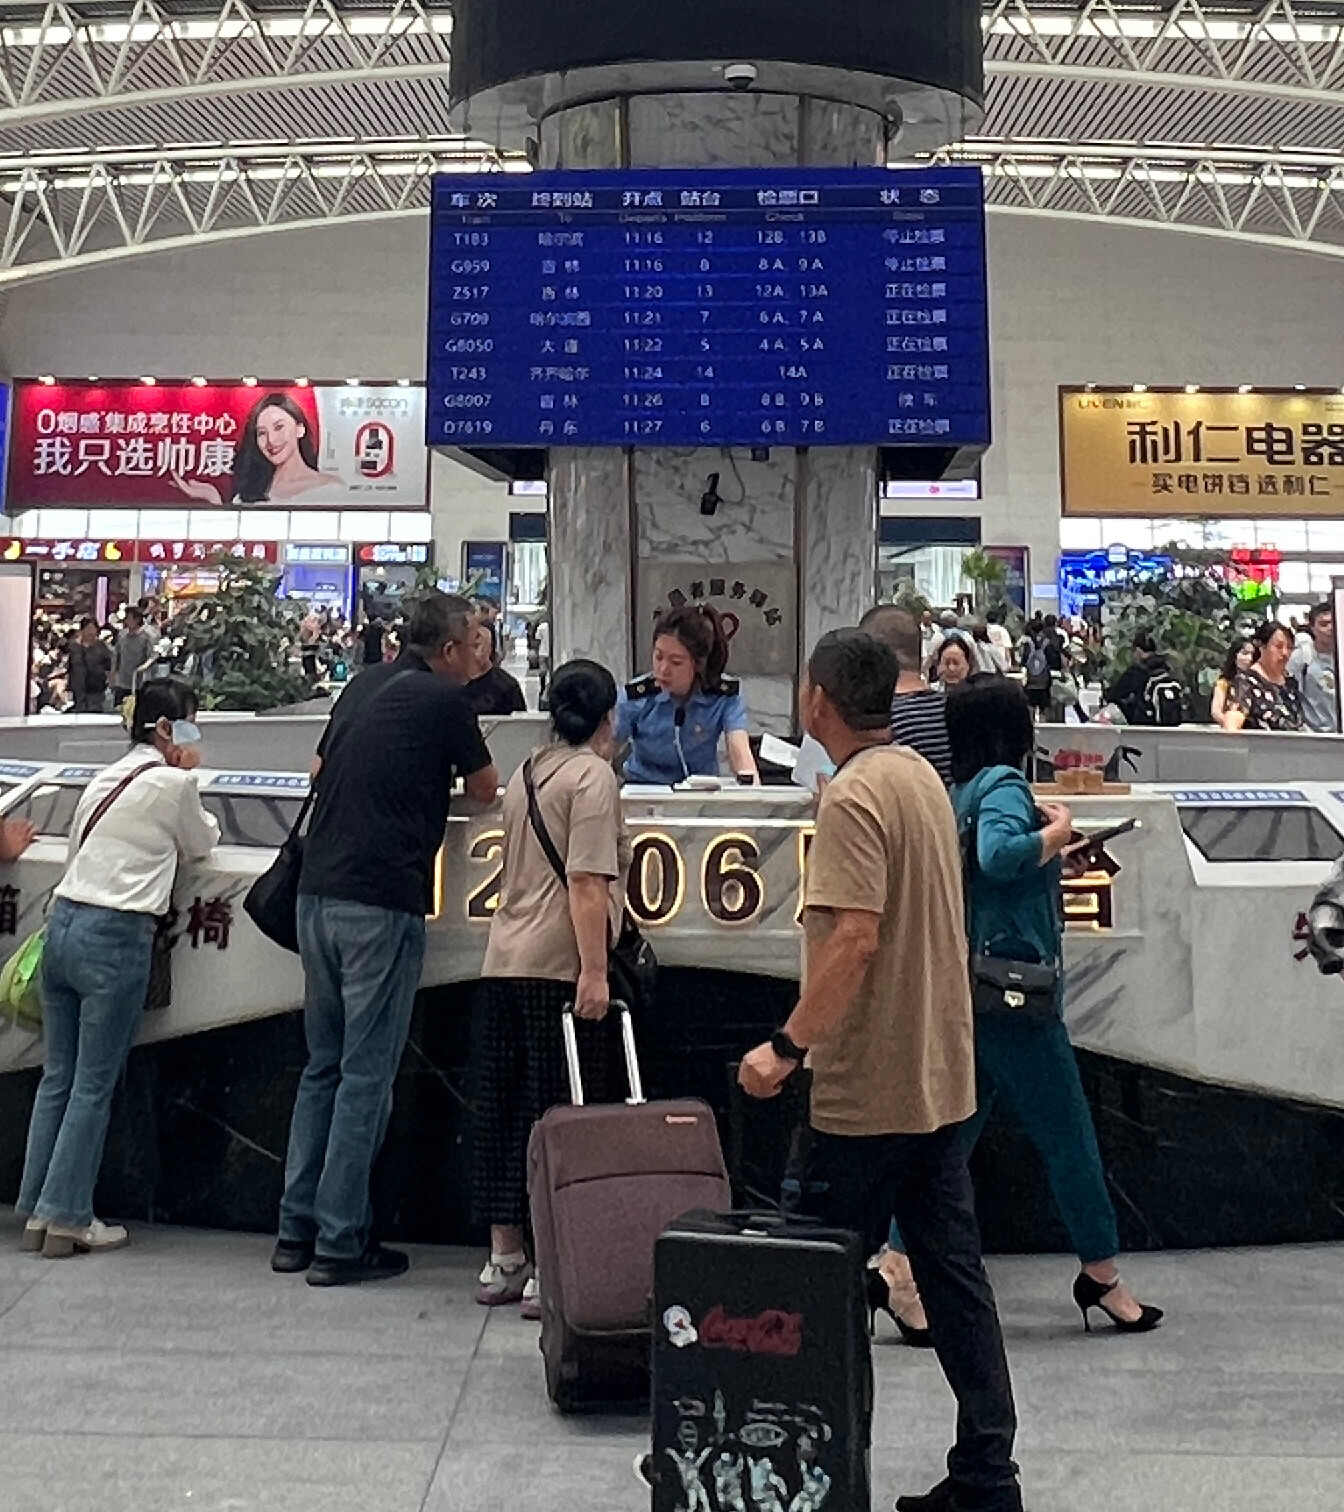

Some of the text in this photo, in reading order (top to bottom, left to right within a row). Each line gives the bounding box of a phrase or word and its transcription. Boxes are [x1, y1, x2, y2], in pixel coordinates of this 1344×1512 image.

[450, 191, 498, 208] 车次
[680, 190, 721, 206] 站台
[33, 437, 237, 478] 我只选帅康
[1151, 472, 1330, 496] 买电饼铛 选利仁
